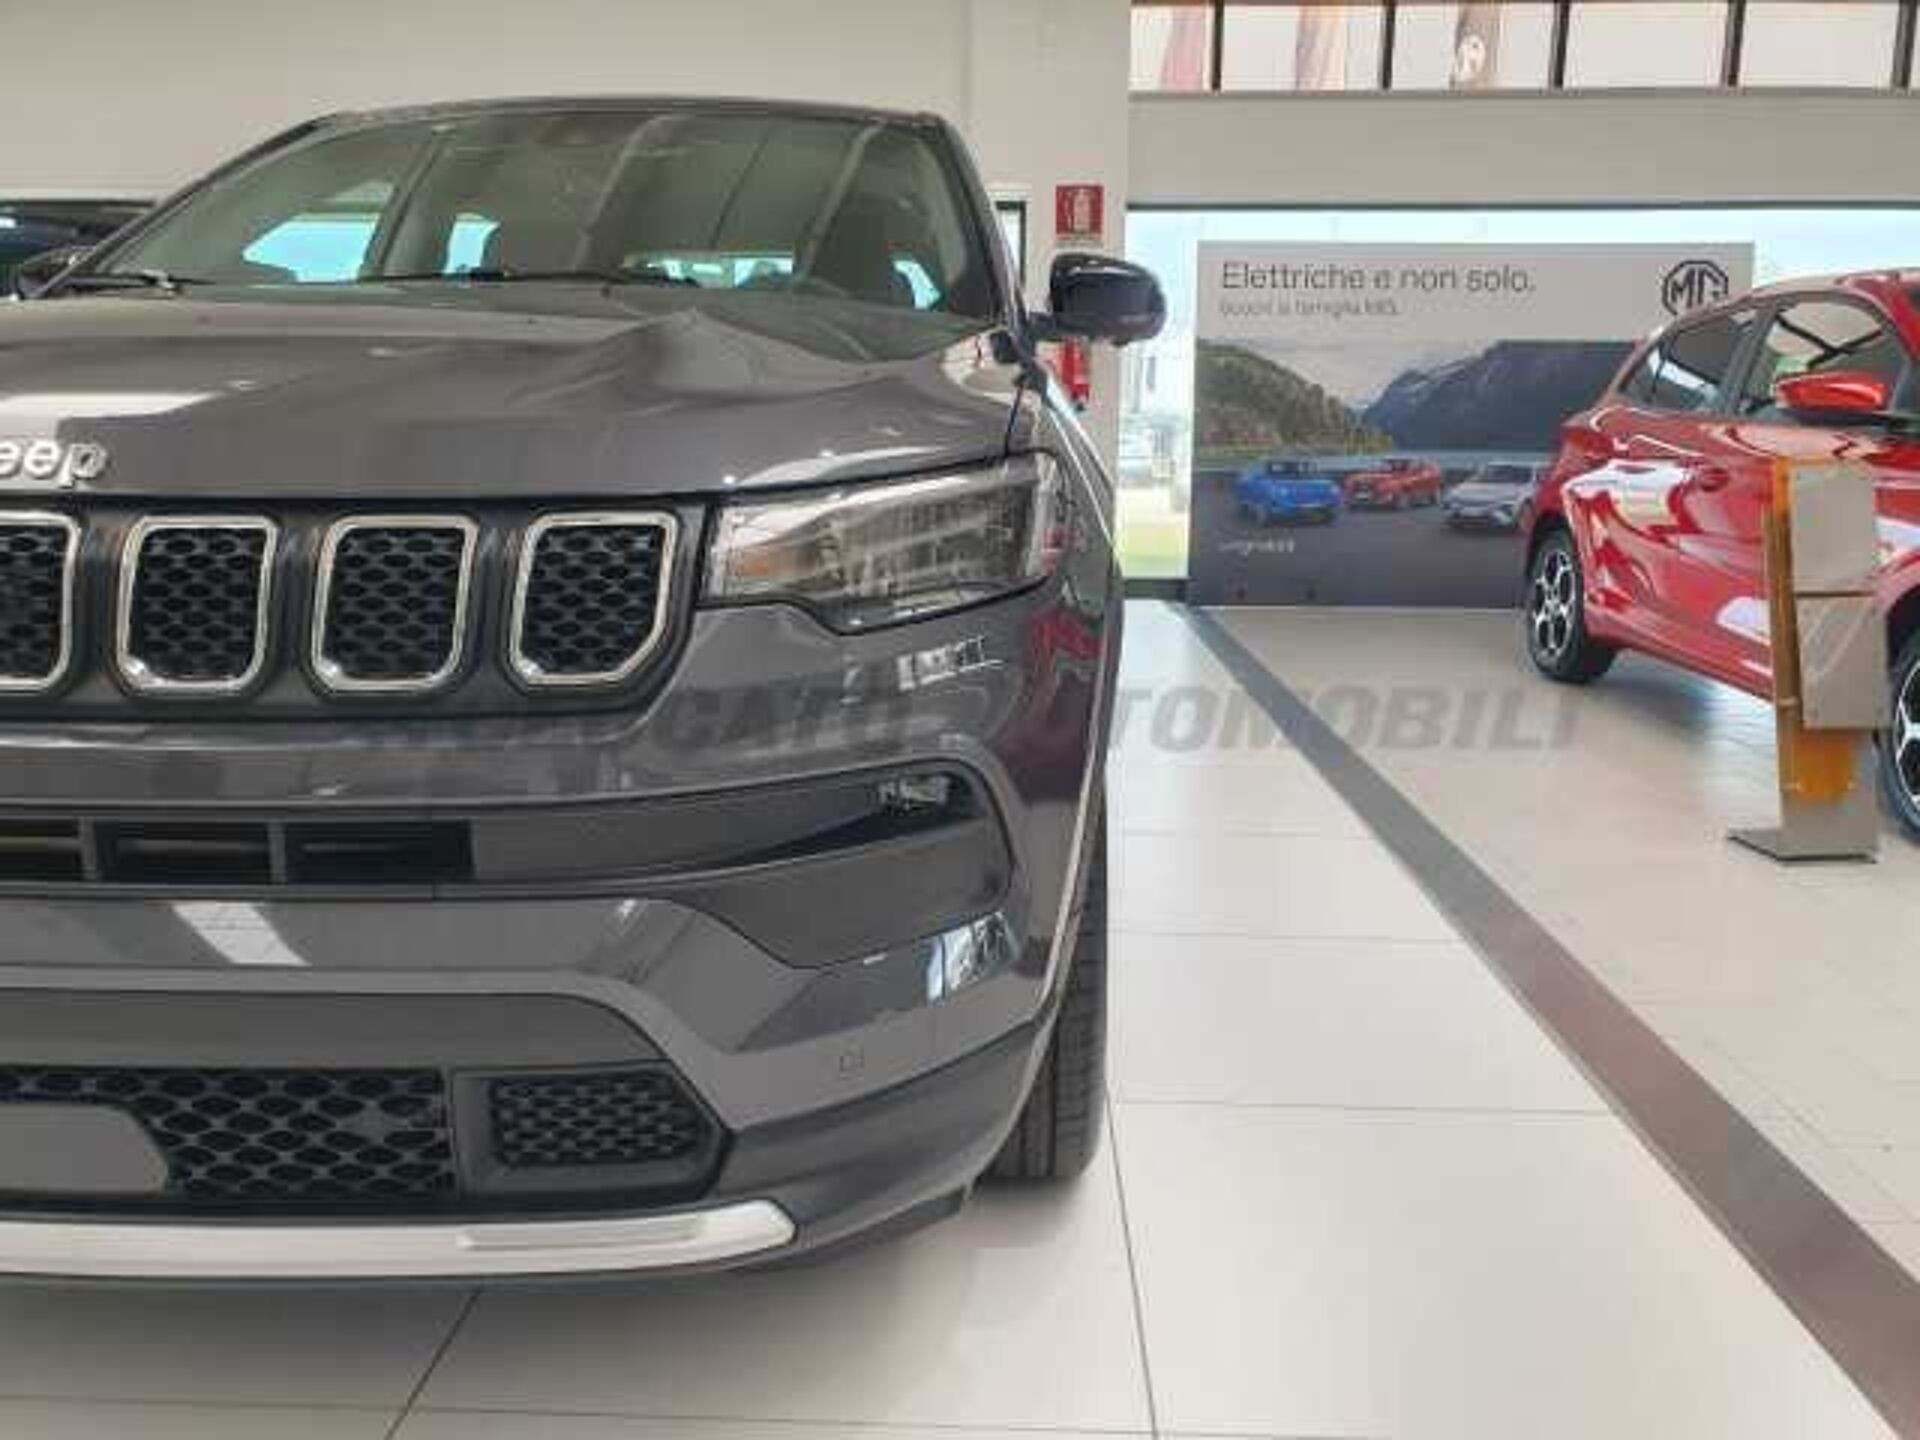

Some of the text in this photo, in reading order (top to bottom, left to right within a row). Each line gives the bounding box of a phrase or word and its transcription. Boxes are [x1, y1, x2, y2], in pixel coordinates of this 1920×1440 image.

[1222, 262, 1537, 292] Elettriche e non solo.
[1667, 263, 1723, 311] MG
